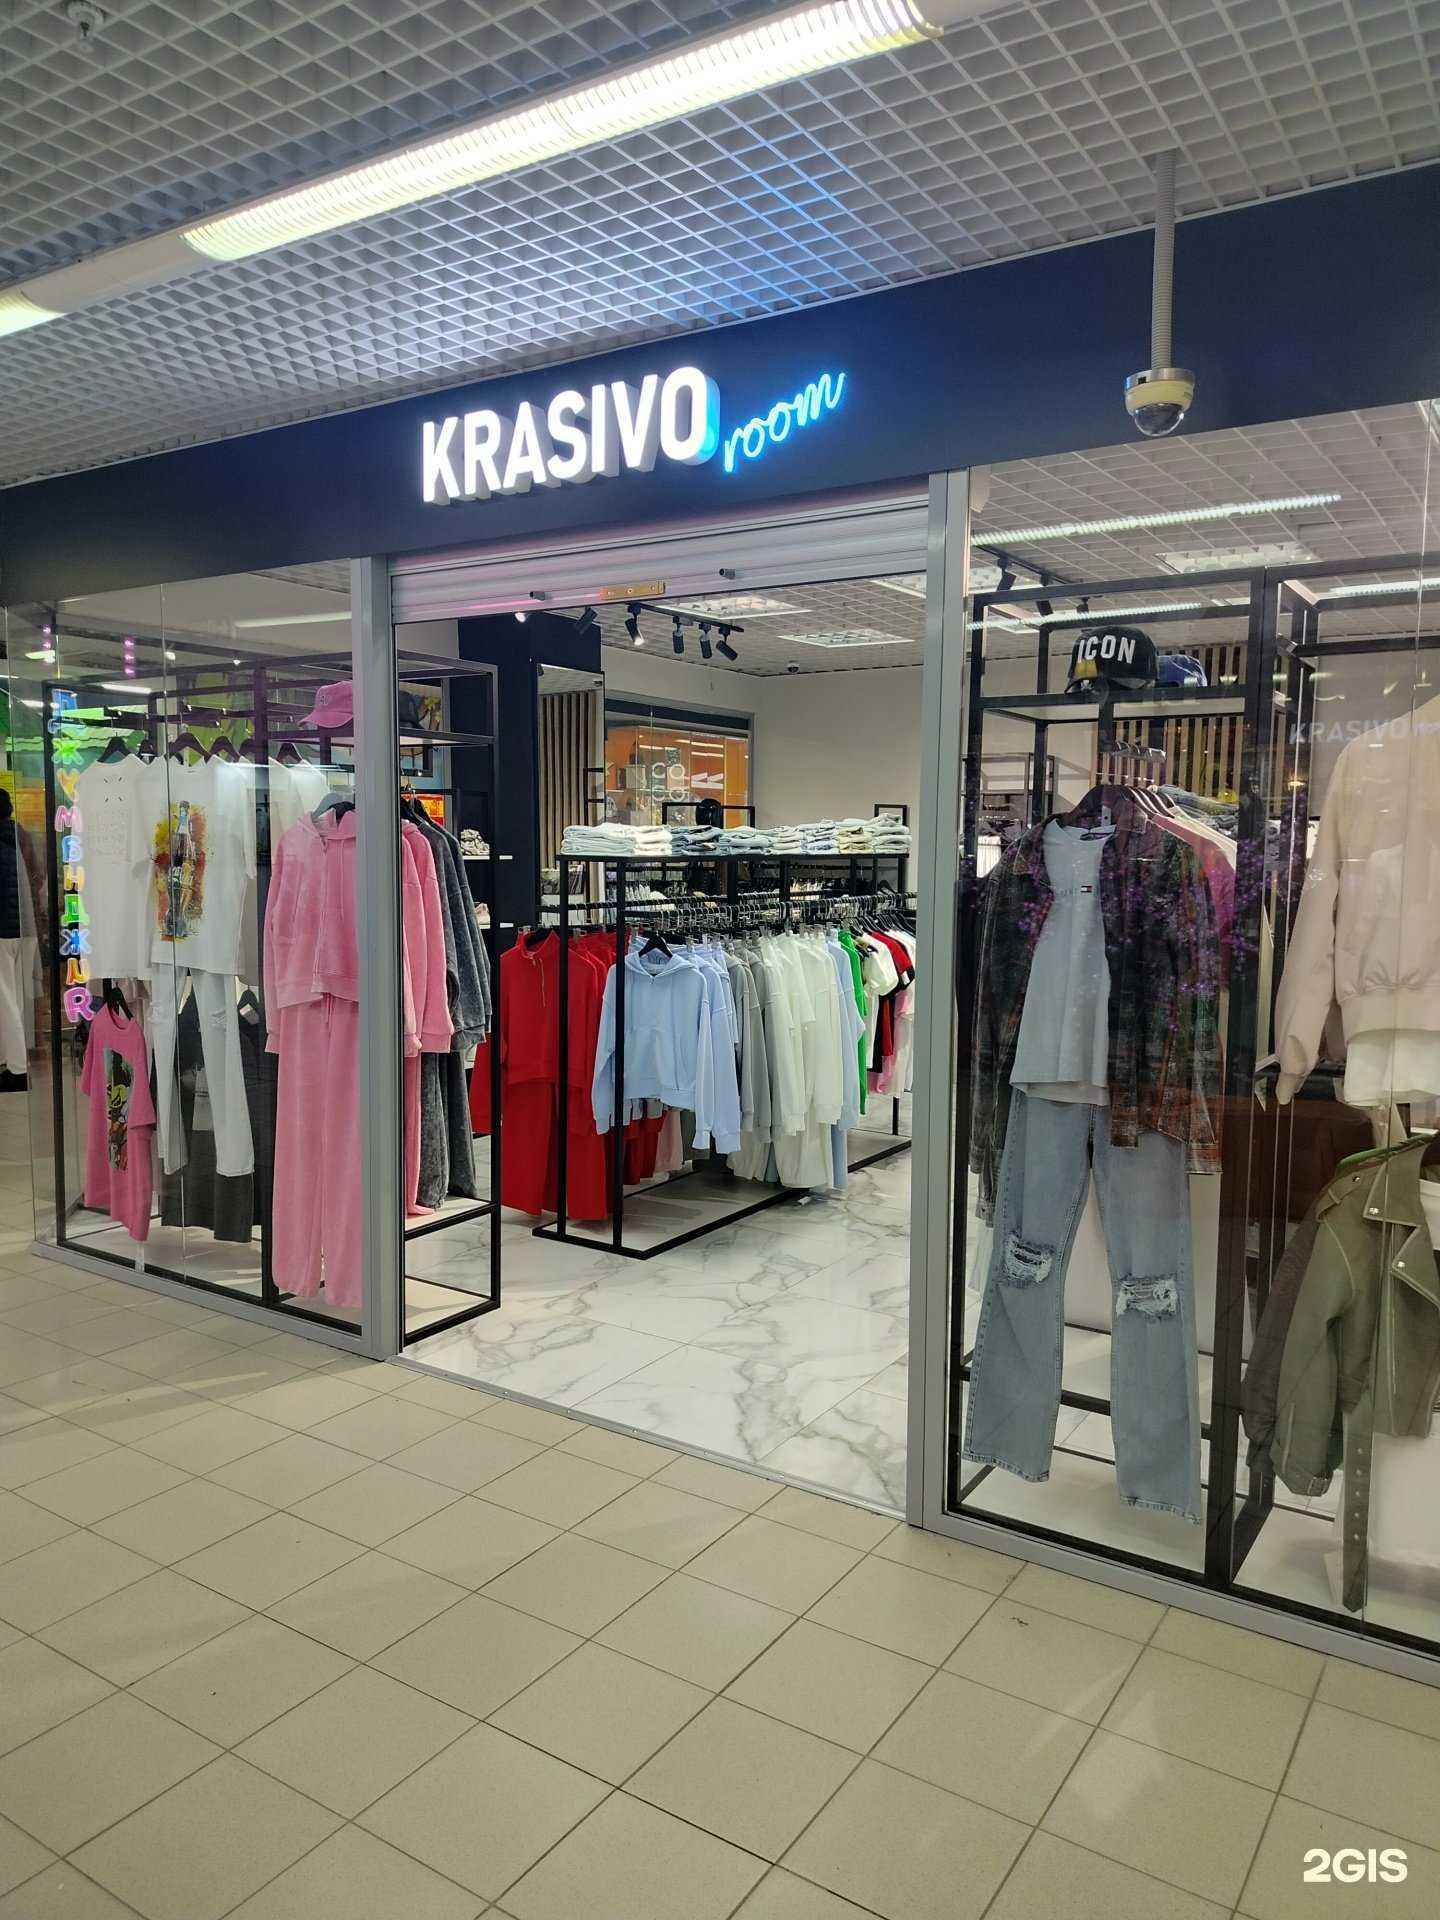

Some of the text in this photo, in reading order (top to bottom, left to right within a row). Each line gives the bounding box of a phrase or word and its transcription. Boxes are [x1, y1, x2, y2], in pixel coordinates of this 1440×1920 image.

[423, 366, 846, 503] KRASIVO room
[1077, 634, 1136, 665] ICON
[1289, 719, 1409, 745] KRASIVO
